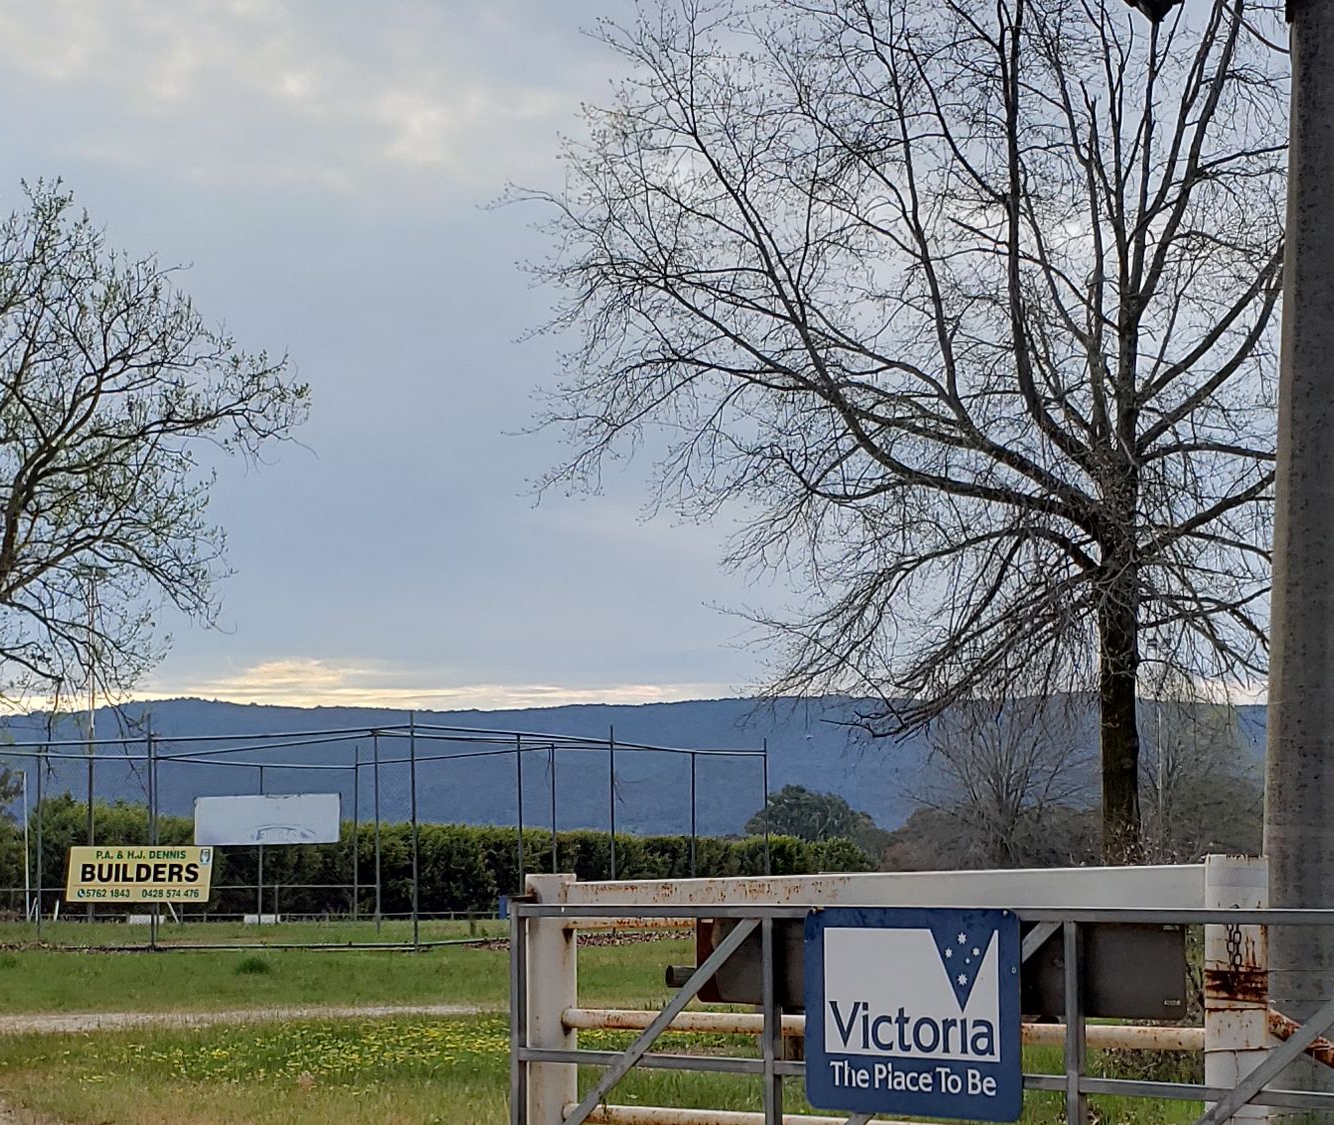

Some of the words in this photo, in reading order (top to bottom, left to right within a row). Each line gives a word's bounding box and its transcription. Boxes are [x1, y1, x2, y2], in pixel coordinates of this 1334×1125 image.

[117, 850, 123, 860] &
[149, 850, 187, 860] DENNIS
[80, 863, 199, 883] BUILDERS
[86, 888, 107, 898] 5762
[142, 888, 164, 898] 0428
[828, 1000, 996, 1057] Victoria
[830, 1060, 870, 1089] The
[873, 1062, 934, 1093] Place
[935, 1066, 963, 1095] To
[966, 1068, 997, 1097] Be
